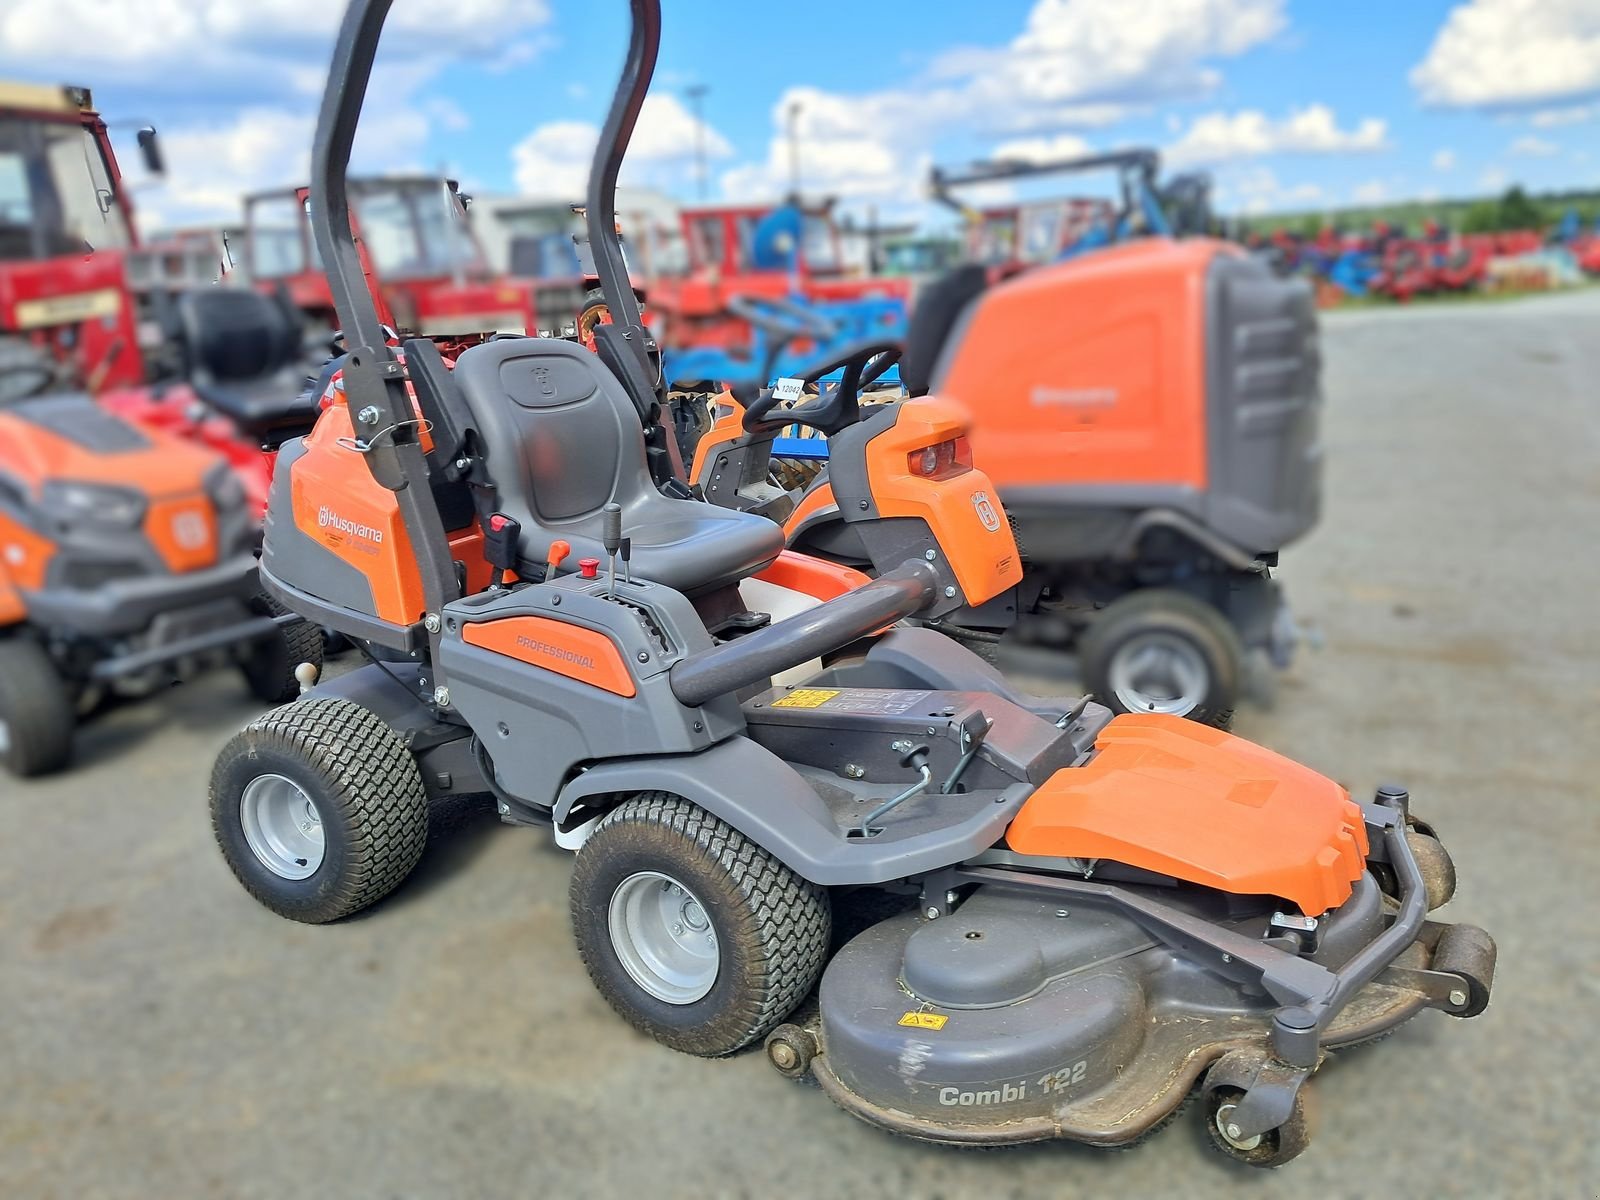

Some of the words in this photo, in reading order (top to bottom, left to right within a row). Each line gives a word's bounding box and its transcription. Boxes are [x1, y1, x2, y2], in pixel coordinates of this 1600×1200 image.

[782, 385, 801, 394] 12042
[328, 512, 383, 543] Husqvarna
[516, 635, 595, 669] PROFESSIONAL
[939, 1081, 1027, 1106] Combi
[1037, 1060, 1088, 1095] 122
